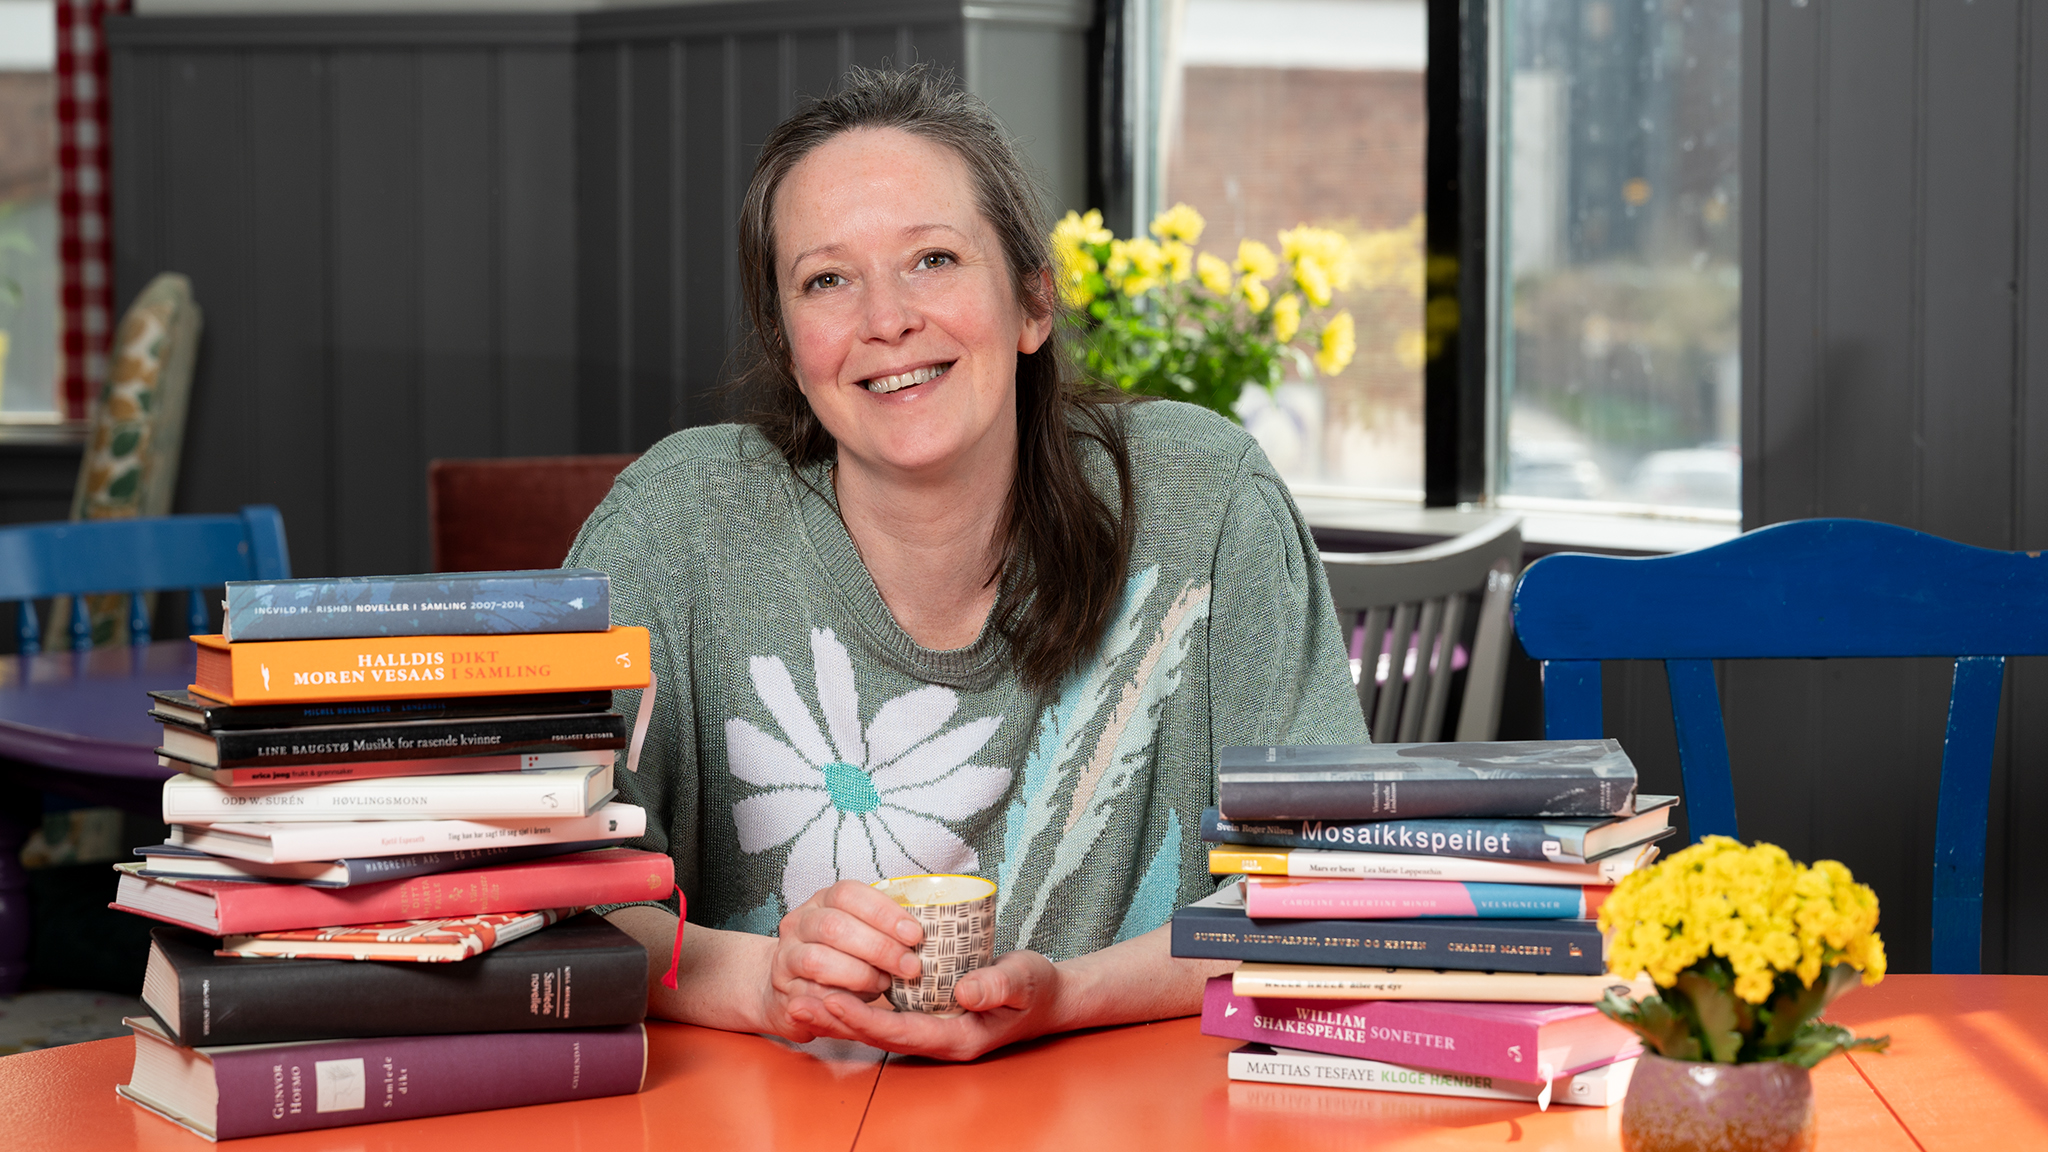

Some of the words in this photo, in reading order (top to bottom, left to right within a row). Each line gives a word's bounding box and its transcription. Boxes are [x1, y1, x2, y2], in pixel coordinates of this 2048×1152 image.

[254, 606, 297, 615] INGVILD
[300, 606, 312, 614] H.
[316, 604, 352, 613] RISHØI
[356, 603, 410, 612] NOVELLER
[420, 602, 467, 611] SAMLING
[357, 651, 445, 667] HALLDIS
[451, 651, 500, 664] DIKT
[294, 670, 366, 685] MOREN
[370, 667, 445, 682] VESAAS
[452, 668, 457, 680] I
[464, 665, 551, 679] SAMLING
[258, 746, 287, 757] LINE
[292, 742, 349, 755] BAUGSTØ
[353, 737, 395, 751] Musikk
[398, 736, 413, 749] for
[417, 734, 459, 748] rasende
[460, 734, 501, 746] kvinner
[272, 771, 290, 780] jong
[292, 769, 309, 778] frukt
[222, 797, 247, 806] ODD
[250, 797, 263, 806] W.
[266, 795, 304, 806] SURÉN
[332, 797, 428, 806] HØVLINGSMONN
[1216, 822, 1240, 832] Svein
[1242, 824, 1266, 835] Roger
[1267, 826, 1294, 835] Nilsen
[1302, 820, 1511, 854] Mosaikkspeilet
[365, 857, 418, 873] MARGRETHE
[423, 854, 441, 864] AAS
[1309, 864, 1329, 872] Mars
[1339, 865, 1355, 873] best
[1282, 899, 1333, 907] CAROLINE
[1339, 899, 1397, 907] ALBERTINE
[1403, 900, 1437, 908] MINOR
[1481, 901, 1560, 909] VELSIGNELSER
[1194, 932, 1240, 944] GUTTEN,
[1244, 934, 1320, 947] MULDVARPEN,
[1324, 937, 1360, 948] REVEN
[1364, 938, 1381, 949] OG
[1384, 940, 1427, 950] HESTEN
[1447, 943, 1497, 953] CHARLIE
[1500, 945, 1552, 955] MACKESY
[530, 973, 541, 1015] noveller
[543, 972, 555, 1015] Samlede
[1296, 1007, 1366, 1029] WILLIAM
[1253, 1015, 1366, 1043] SHAKESPEARE
[1370, 1026, 1456, 1051] SONETTER
[1247, 1061, 1310, 1077] MATTIAS
[1314, 1066, 1375, 1082] TESFAYE
[1381, 1070, 1426, 1085] KLOGE
[1430, 1074, 1493, 1089] HÆNDER
[383, 1056, 393, 1108] Samlede
[398, 1068, 408, 1095] dikt
